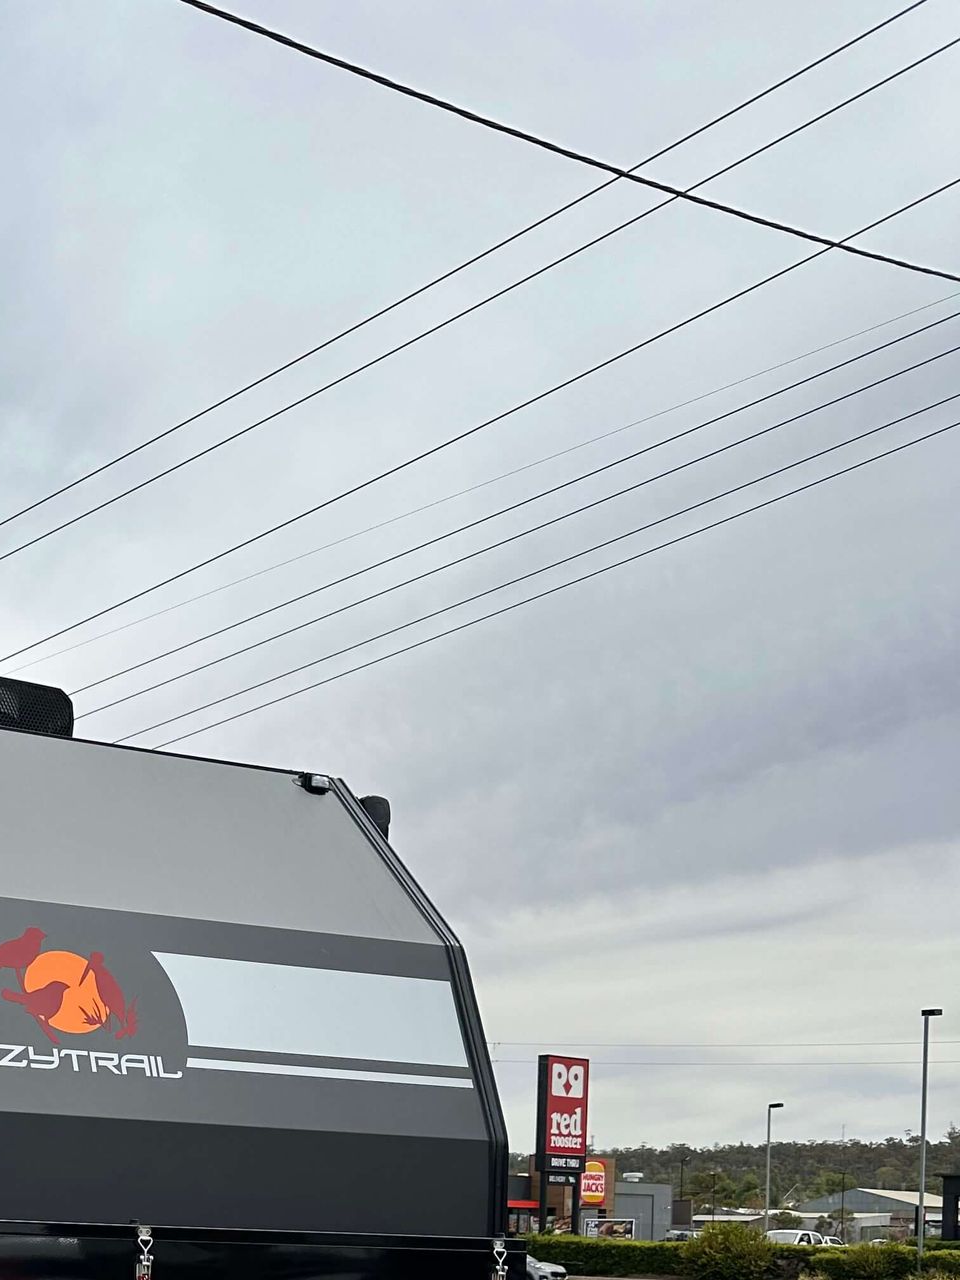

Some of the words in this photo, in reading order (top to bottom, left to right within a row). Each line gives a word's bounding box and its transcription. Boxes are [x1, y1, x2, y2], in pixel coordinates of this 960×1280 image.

[551, 1107, 582, 1135] red
[550, 1135, 582, 1149] rooster
[551, 1158, 566, 1167] DRIVE
[567, 1159, 580, 1168] THRU
